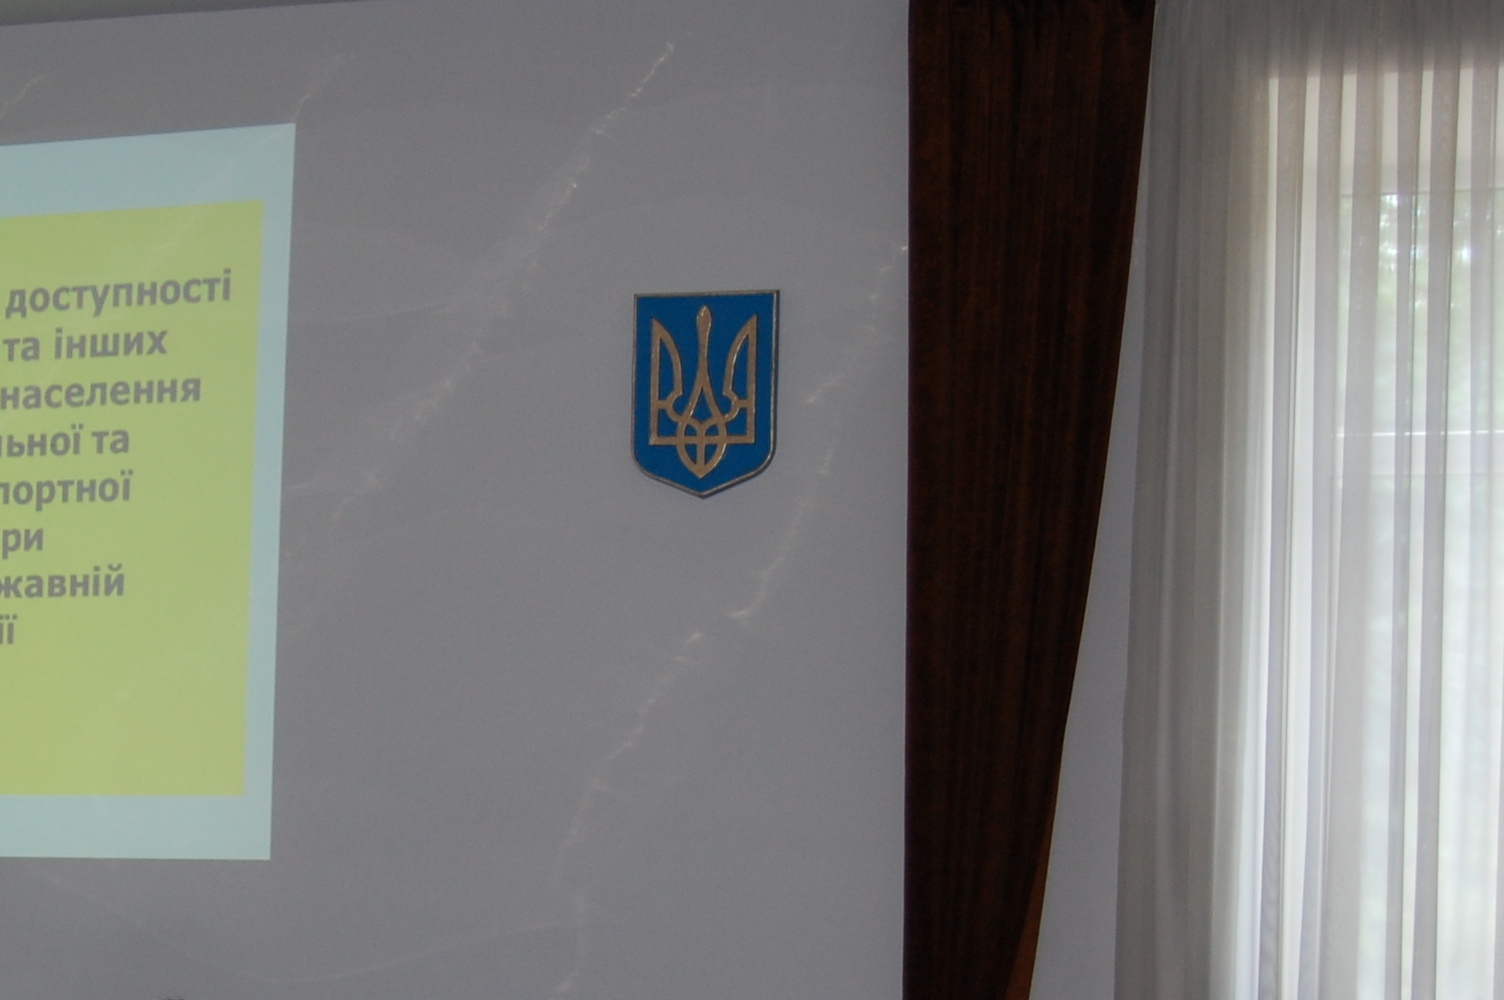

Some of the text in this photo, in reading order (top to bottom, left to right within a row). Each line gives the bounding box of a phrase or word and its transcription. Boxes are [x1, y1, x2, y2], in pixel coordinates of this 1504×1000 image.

[5, 269, 231, 319] доступності
[3, 337, 41, 362] та
[54, 327, 168, 360] інших
[0, 377, 202, 410] населення
[92, 429, 130, 455] та
